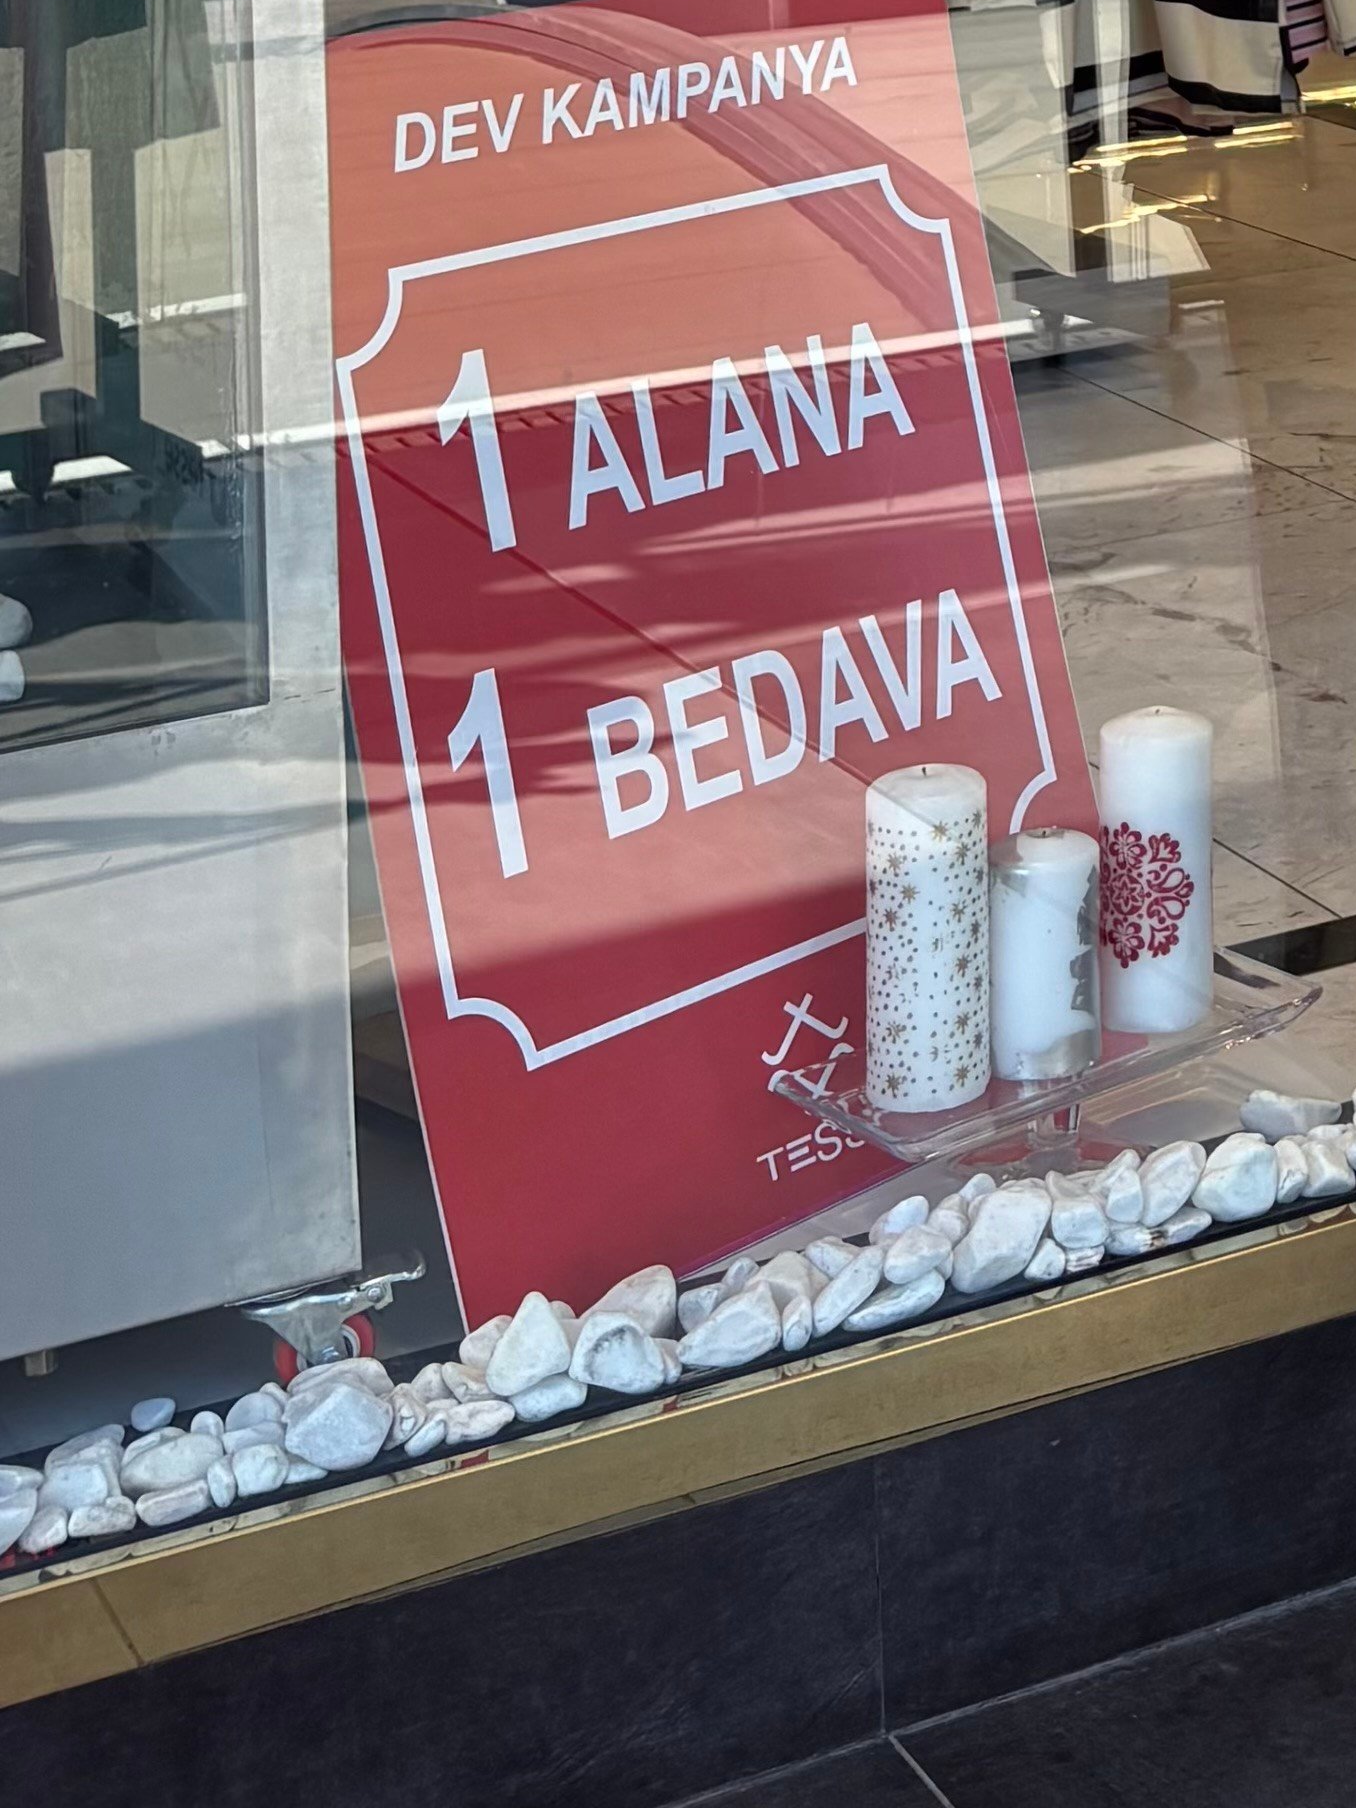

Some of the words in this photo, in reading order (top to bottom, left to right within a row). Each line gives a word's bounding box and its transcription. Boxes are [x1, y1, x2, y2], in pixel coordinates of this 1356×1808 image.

[393, 95, 524, 172] DEV
[541, 36, 859, 145] KAMPANYA
[437, 349, 519, 553] 1
[569, 322, 916, 531] ALANA
[447, 669, 529, 879] 1
[587, 588, 1003, 840] BEDAVA
[756, 1120, 865, 1181] TES
